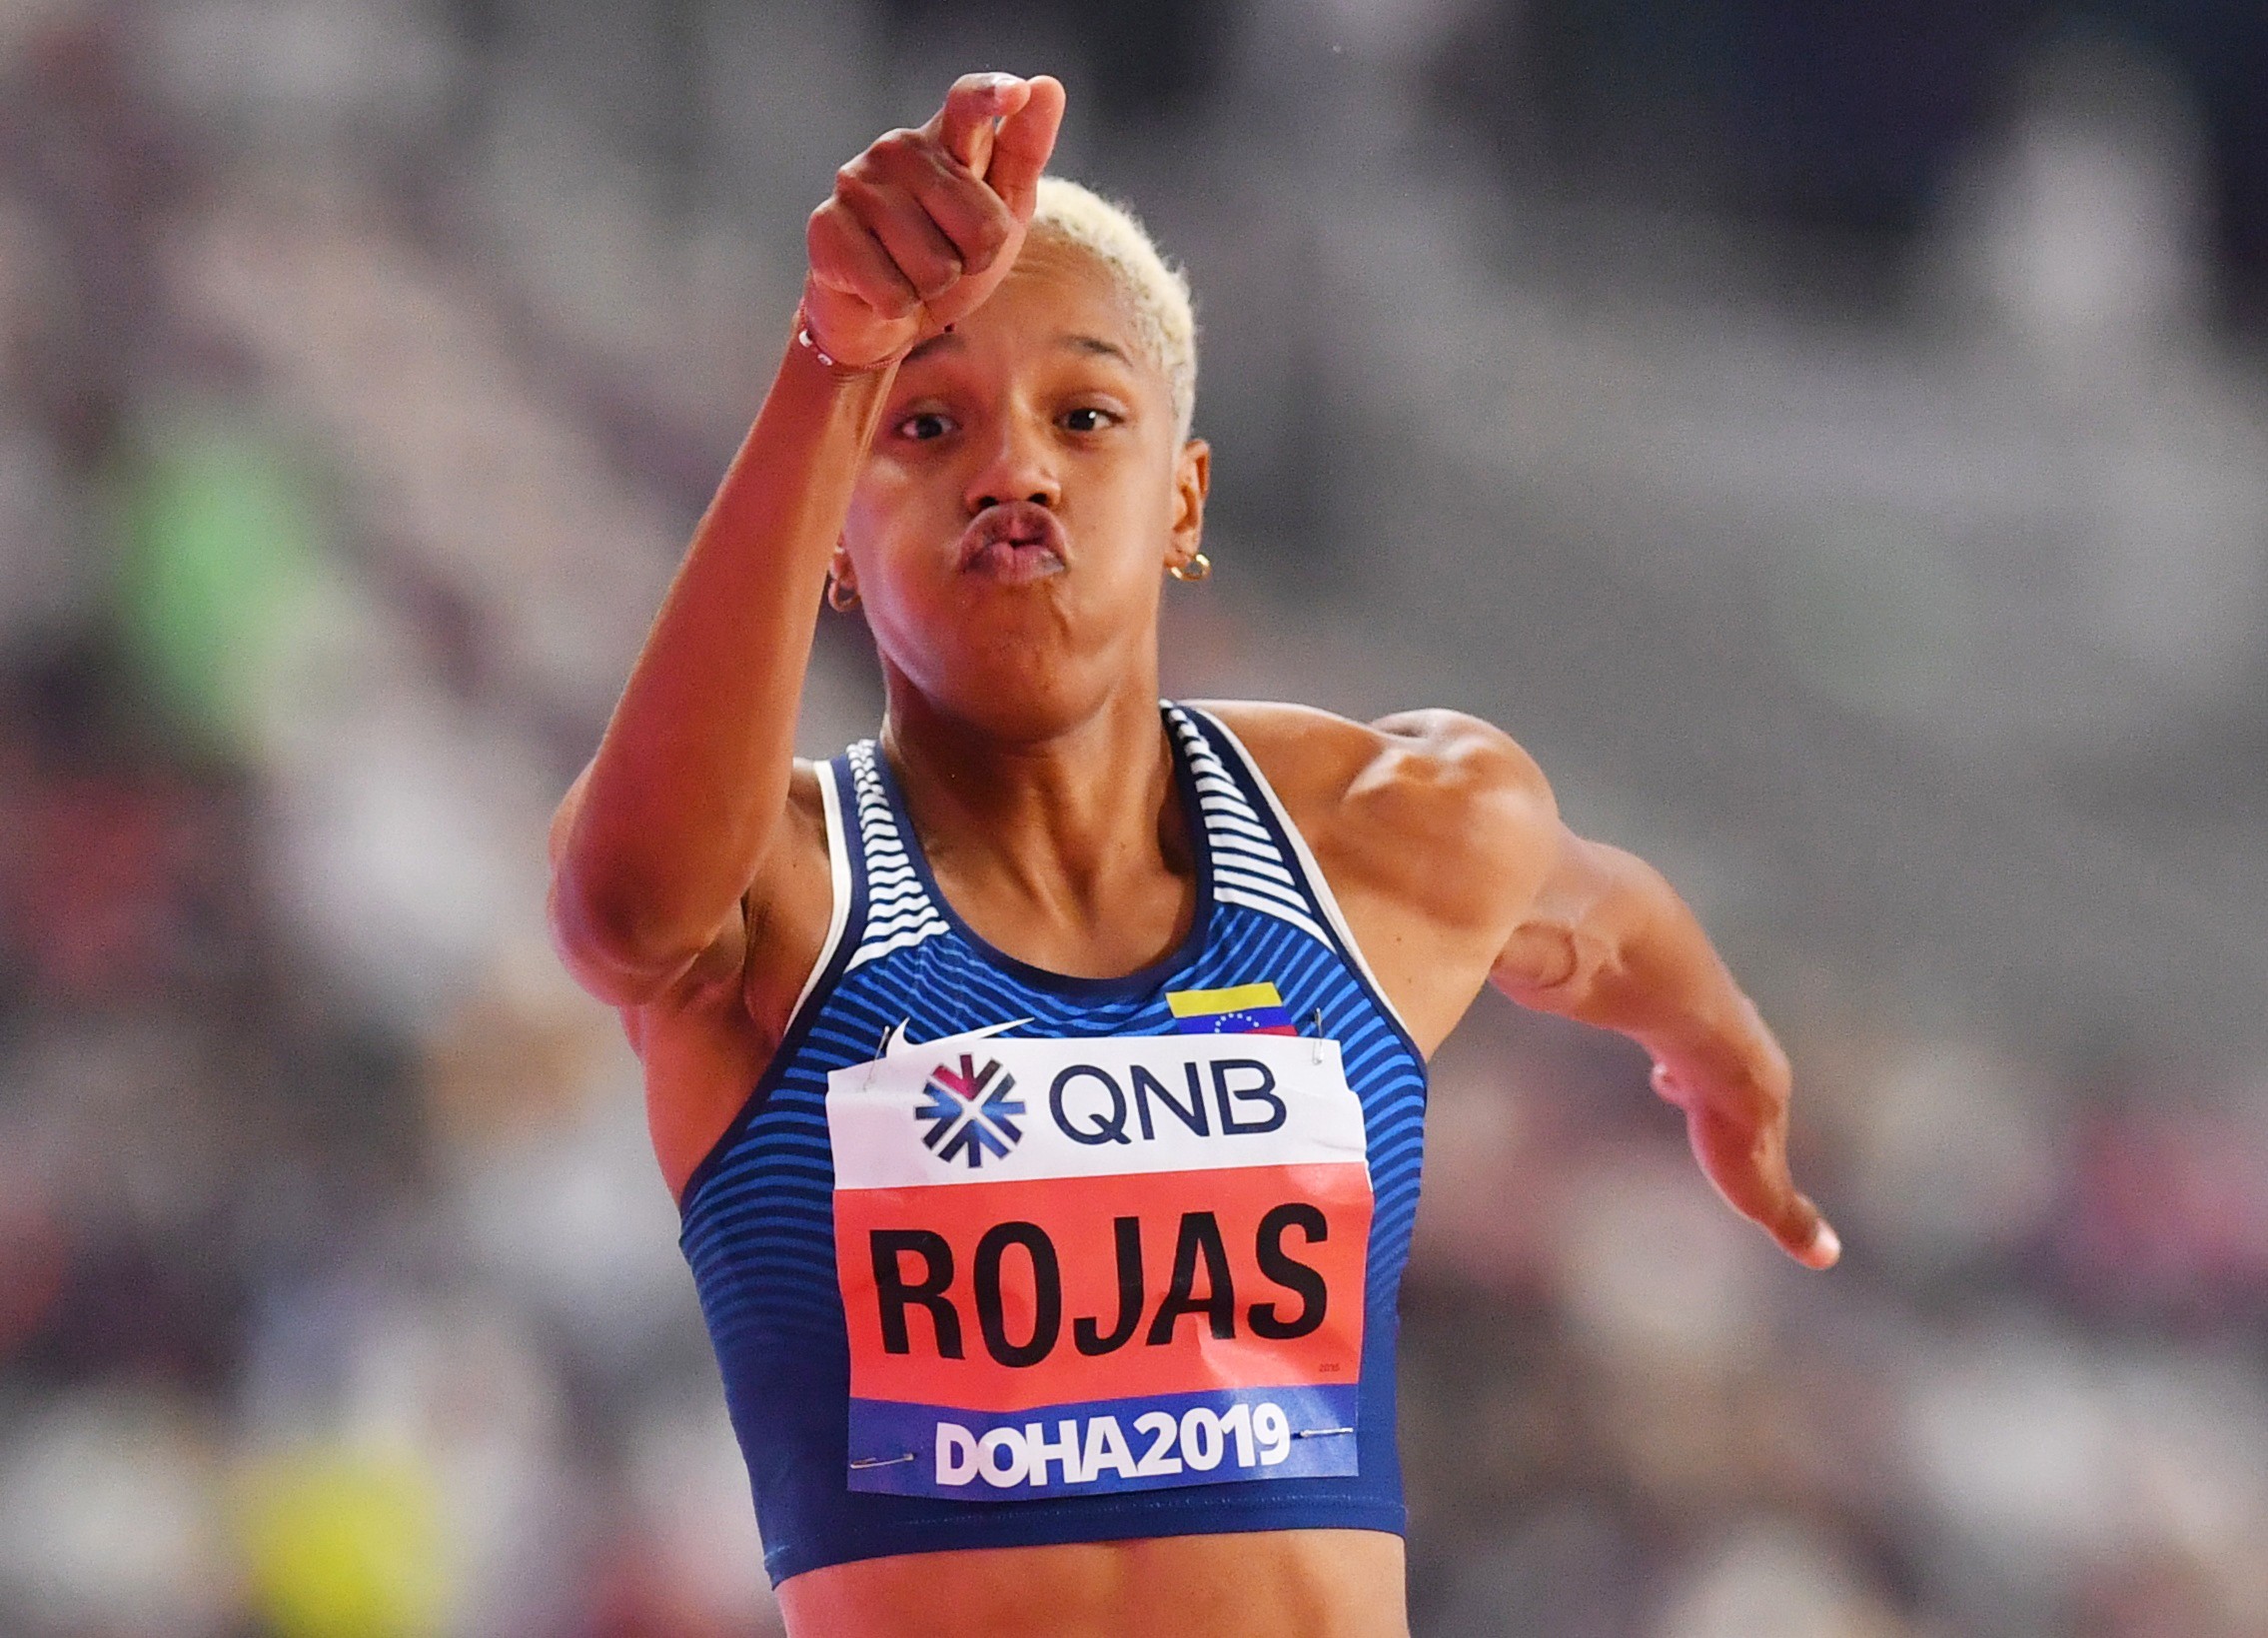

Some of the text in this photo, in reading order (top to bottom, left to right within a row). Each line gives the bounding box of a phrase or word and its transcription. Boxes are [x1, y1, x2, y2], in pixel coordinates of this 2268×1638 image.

[1049, 1058, 1287, 1145] QNB
[868, 1202, 1329, 1368] ROJAS
[935, 1401, 1292, 1488] DOHA2019
